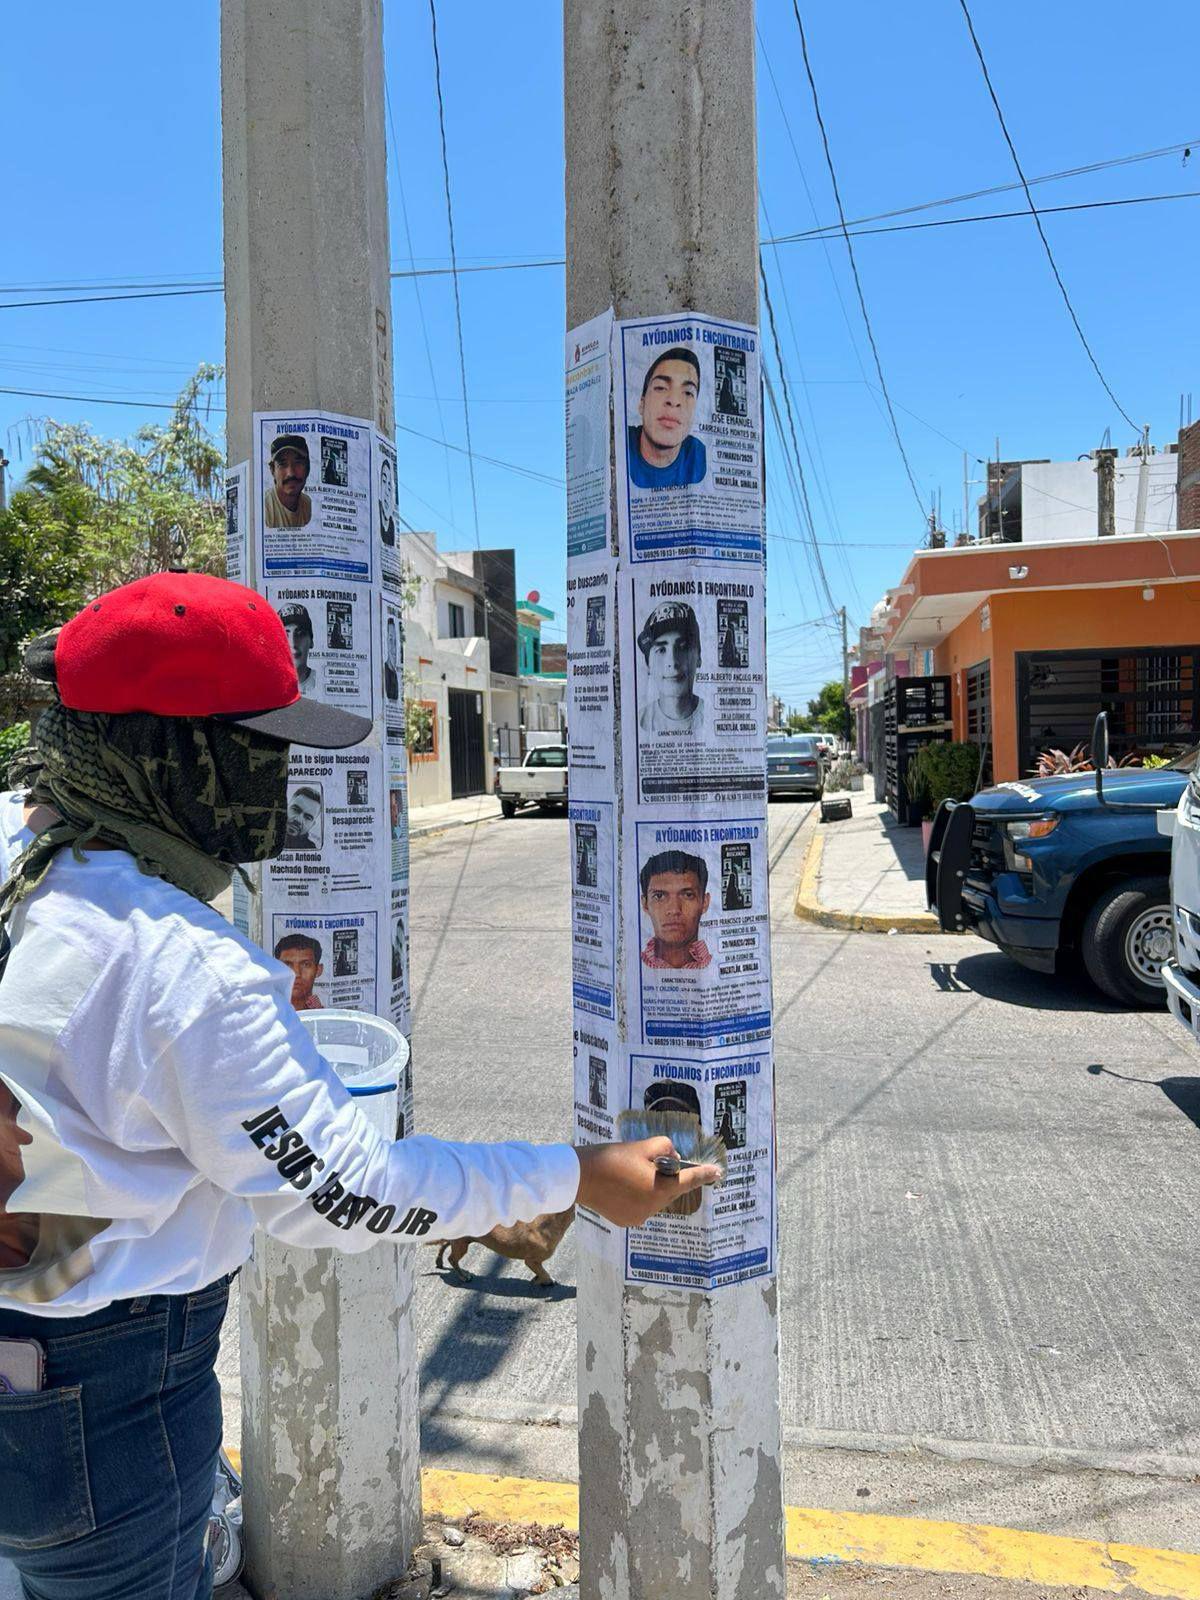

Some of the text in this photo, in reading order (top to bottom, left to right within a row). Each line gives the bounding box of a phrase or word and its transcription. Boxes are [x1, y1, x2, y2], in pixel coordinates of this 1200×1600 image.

[642, 326, 755, 352] AYÚDANOS A ENCONTRARLO
[276, 422, 360, 440] AYÚDANOS A ENCONTRARLO
[577, 573, 608, 589] buscando
[650, 580, 754, 598] AYÚDANOS A ENCONTRARLO
[277, 588, 358, 602] AYÚDANOS A ENCONTRARLO
[288, 754, 370, 765] LMA te sigue buscando
[288, 768, 333, 776] APARECIDO
[332, 815, 375, 826] Desapareció:
[655, 826, 759, 843] AYÚDANOS A ENCONTRARLO
[295, 852, 322, 862] Antonio
[270, 865, 331, 874] Machado Romero
[285, 917, 365, 929] AYÚDANOS A ENCONTRARLO
[580, 1030, 608, 1052] buscando
[653, 1061, 761, 1082] AYÚDANOS A ENCONTRARLO
[241, 1105, 325, 1190] JESUS
[391, 1207, 438, 1236] JR
